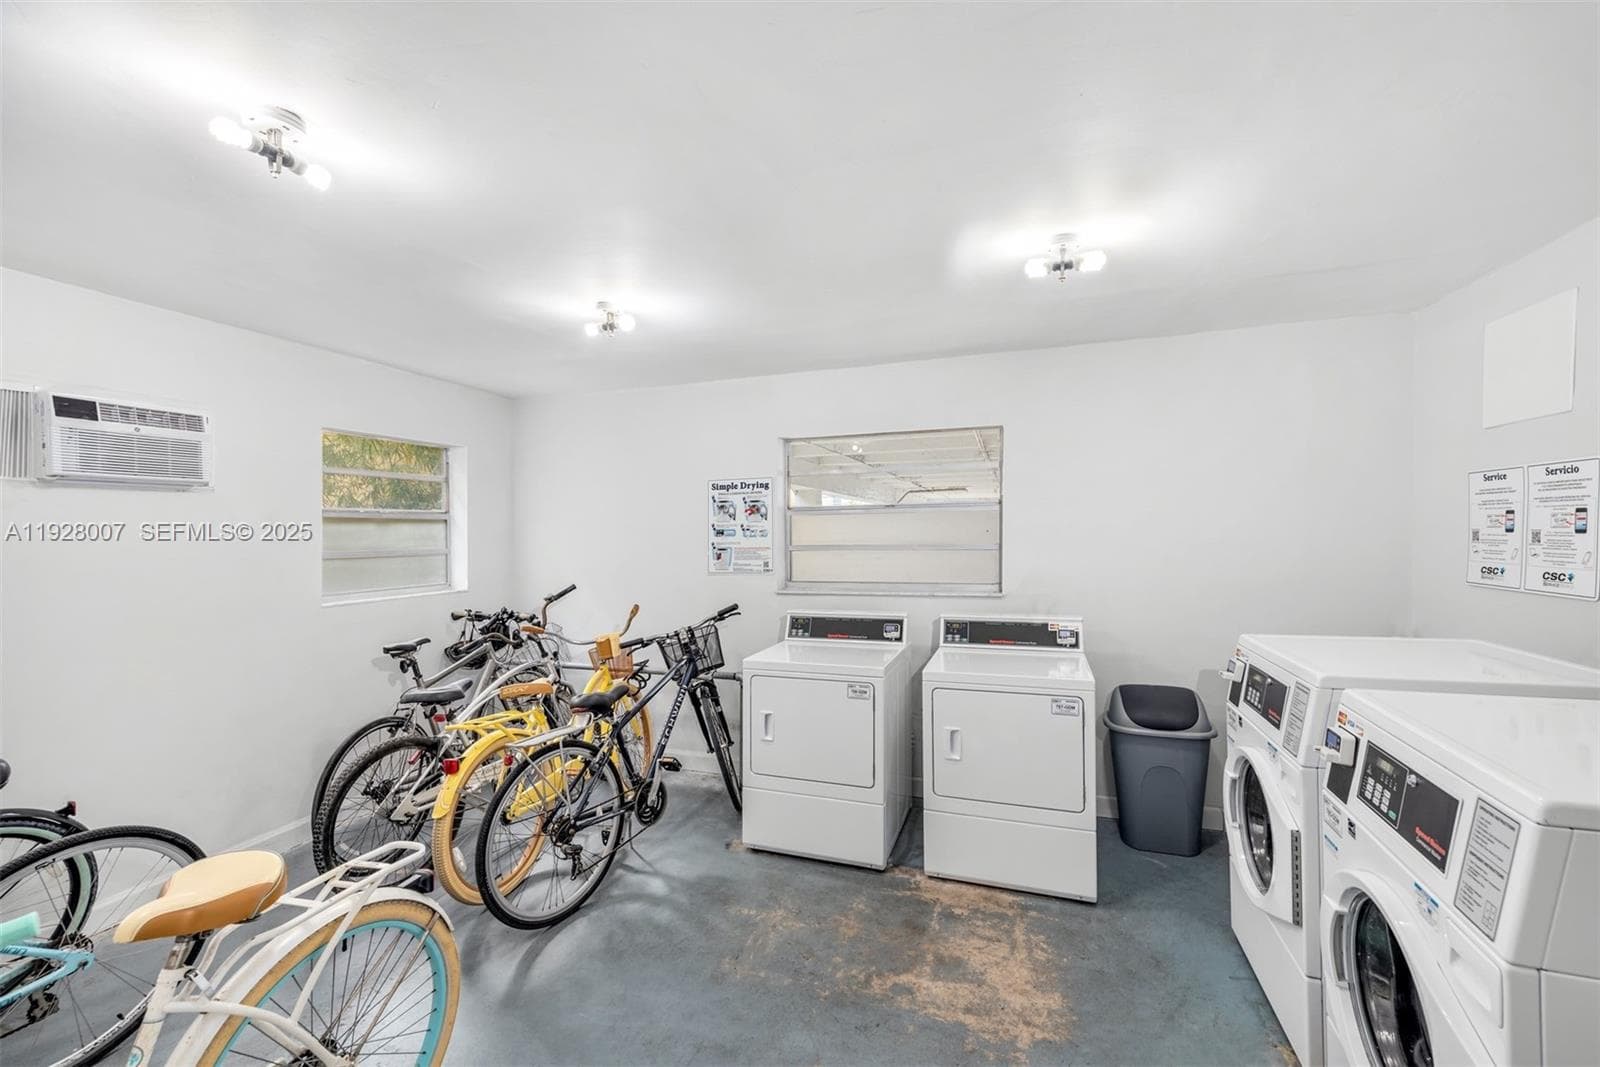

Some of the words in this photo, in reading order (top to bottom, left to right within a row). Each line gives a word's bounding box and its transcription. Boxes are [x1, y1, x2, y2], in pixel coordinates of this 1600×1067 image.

[1545, 465, 1580, 476] Servicio
[1483, 473, 1507, 482] Service
[711, 482, 738, 492] Simple
[740, 481, 770, 491] Drying
[1480, 566, 1500, 575] CSC
[1542, 571, 1567, 582] CSC
